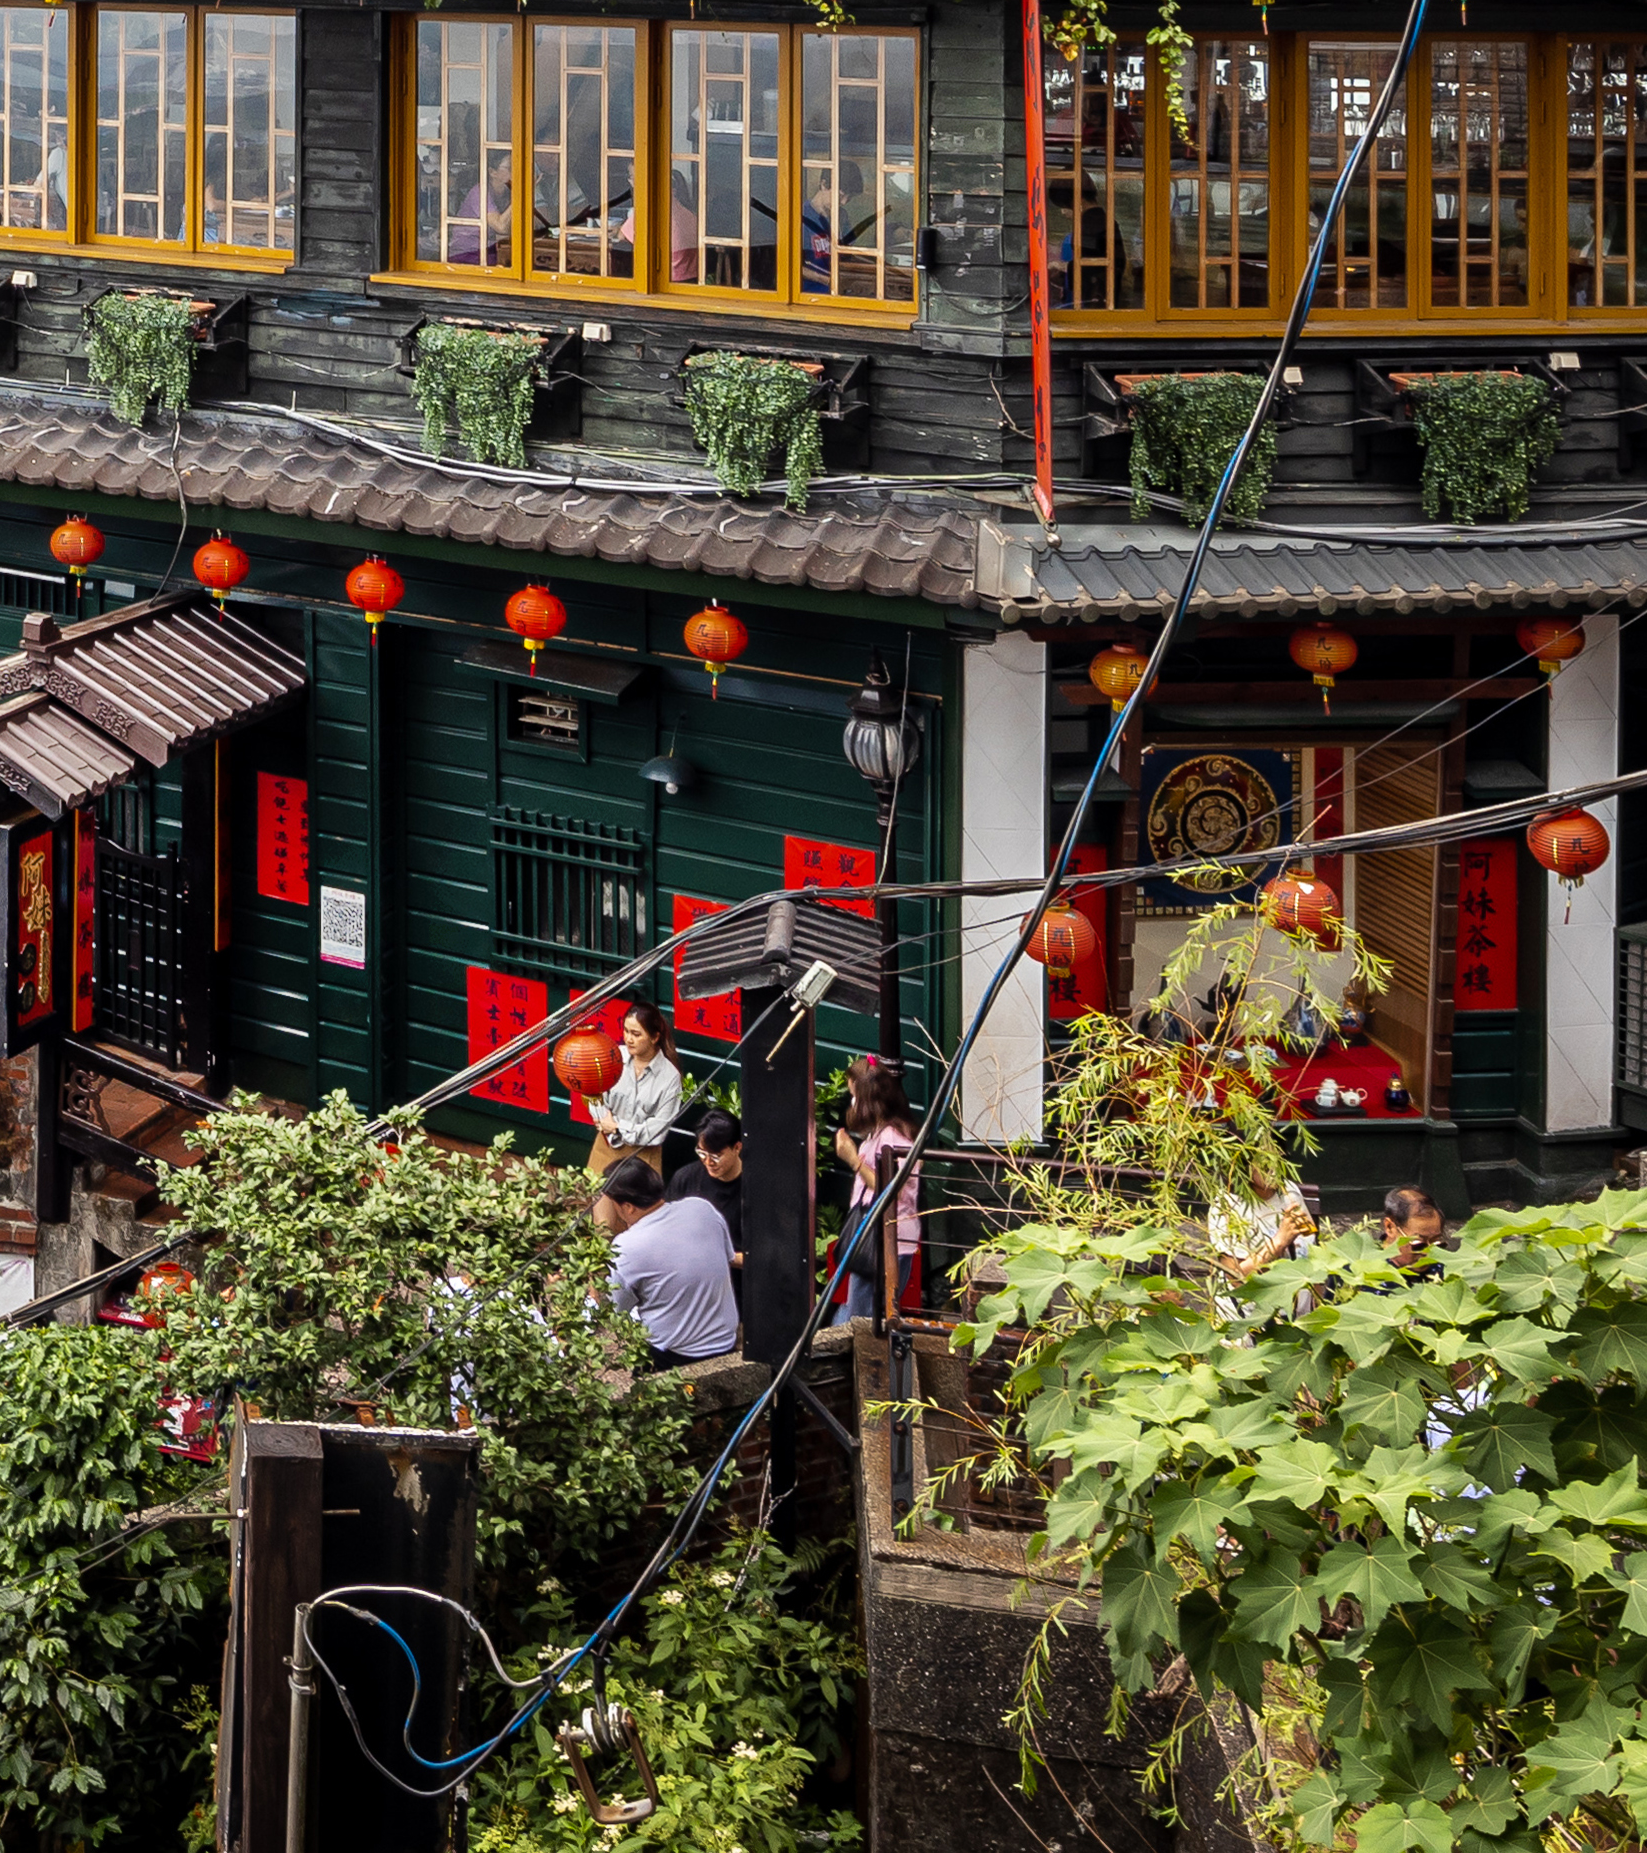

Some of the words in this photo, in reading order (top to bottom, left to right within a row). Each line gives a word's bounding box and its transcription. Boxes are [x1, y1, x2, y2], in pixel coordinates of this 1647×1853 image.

[1462, 852, 1497, 995] 阿妹茶樓
[563, 1051, 582, 1091] 九份
